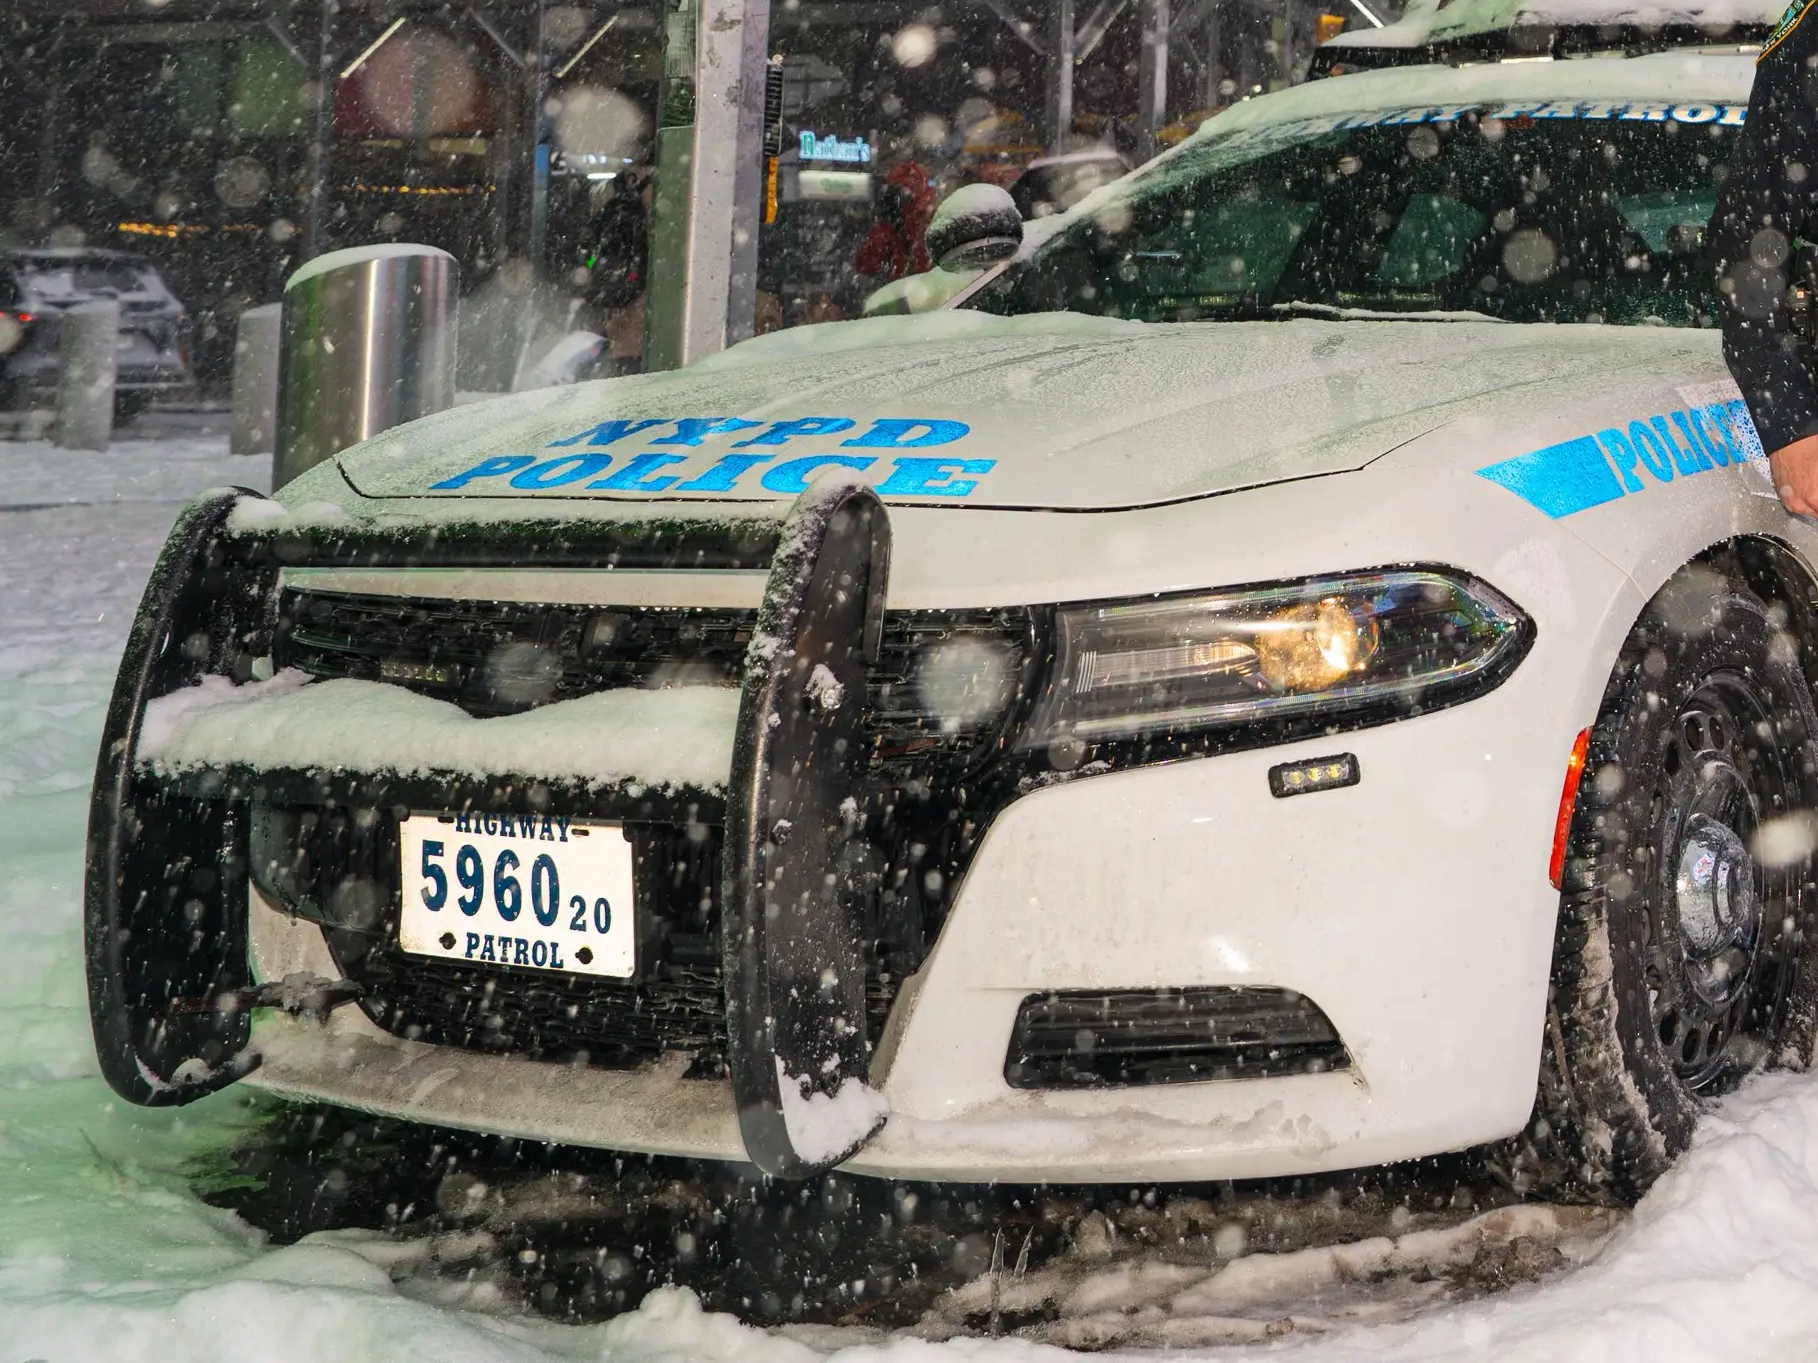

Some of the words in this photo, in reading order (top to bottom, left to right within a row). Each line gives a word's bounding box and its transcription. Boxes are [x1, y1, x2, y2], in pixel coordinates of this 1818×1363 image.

[545, 417, 970, 448] NYPD
[1596, 398, 1749, 494] POLICE
[428, 452, 998, 496] POLICE
[455, 812, 571, 842] HIGHWAY
[420, 839, 560, 927] 5960
[570, 894, 612, 934] 20
[465, 931, 564, 969] PATROL
